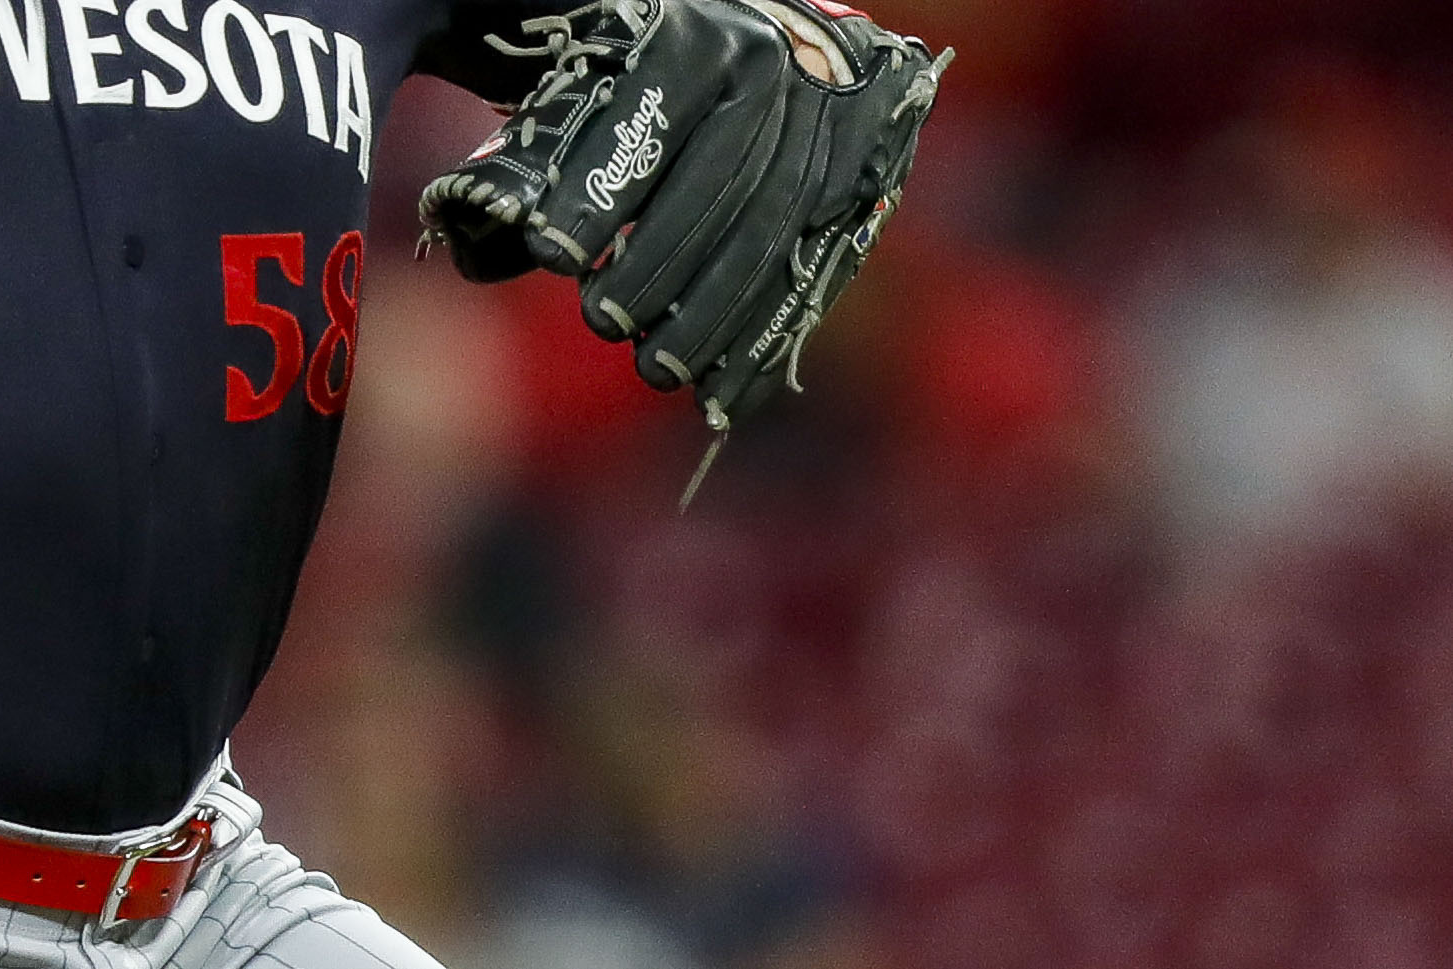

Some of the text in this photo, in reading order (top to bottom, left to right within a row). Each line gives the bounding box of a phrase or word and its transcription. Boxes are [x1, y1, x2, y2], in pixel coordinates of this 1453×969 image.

[585, 86, 669, 211] Rawlings
[221, 229, 364, 422] 58
[770, 292, 799, 332] GOLD
